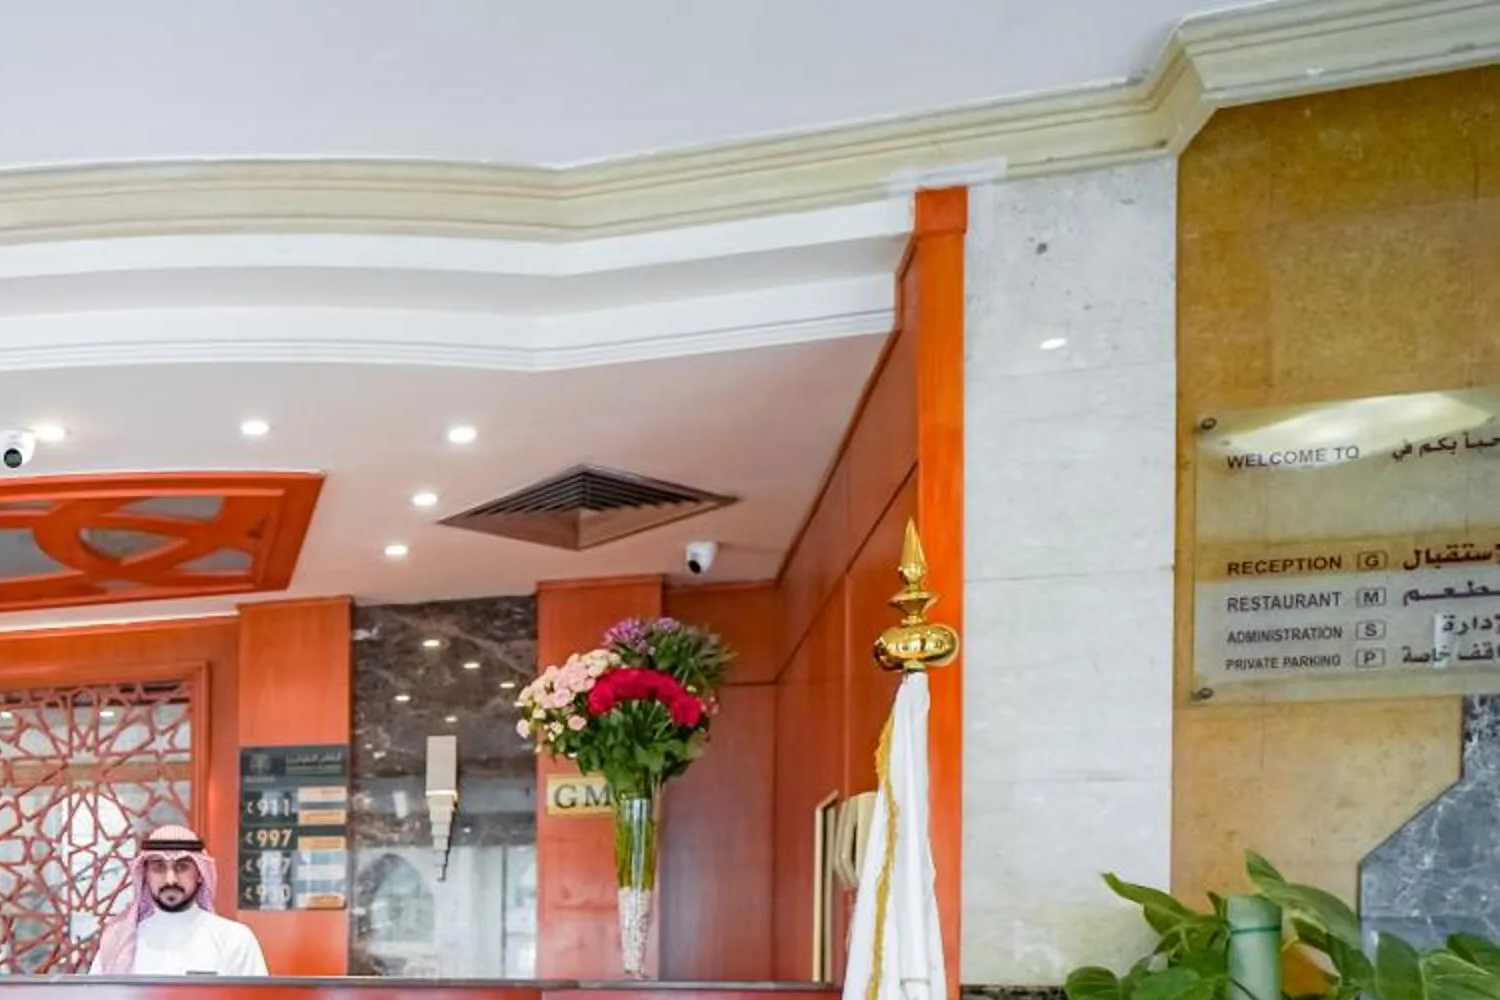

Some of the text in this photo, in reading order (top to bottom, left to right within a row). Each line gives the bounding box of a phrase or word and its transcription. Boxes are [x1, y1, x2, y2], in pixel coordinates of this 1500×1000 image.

[1227, 445, 1360, 469] WELCOME TO
[1227, 554, 1379, 577] RECEPTION G
[1226, 591, 1379, 612] RESTAURANT M
[1226, 623, 1377, 644] ADMINISTRATION S
[1225, 651, 1376, 671] PRIVATE PARKING P
[554, 783, 612, 809] GM
[257, 799, 290, 817] 911
[257, 829, 293, 848] 997
